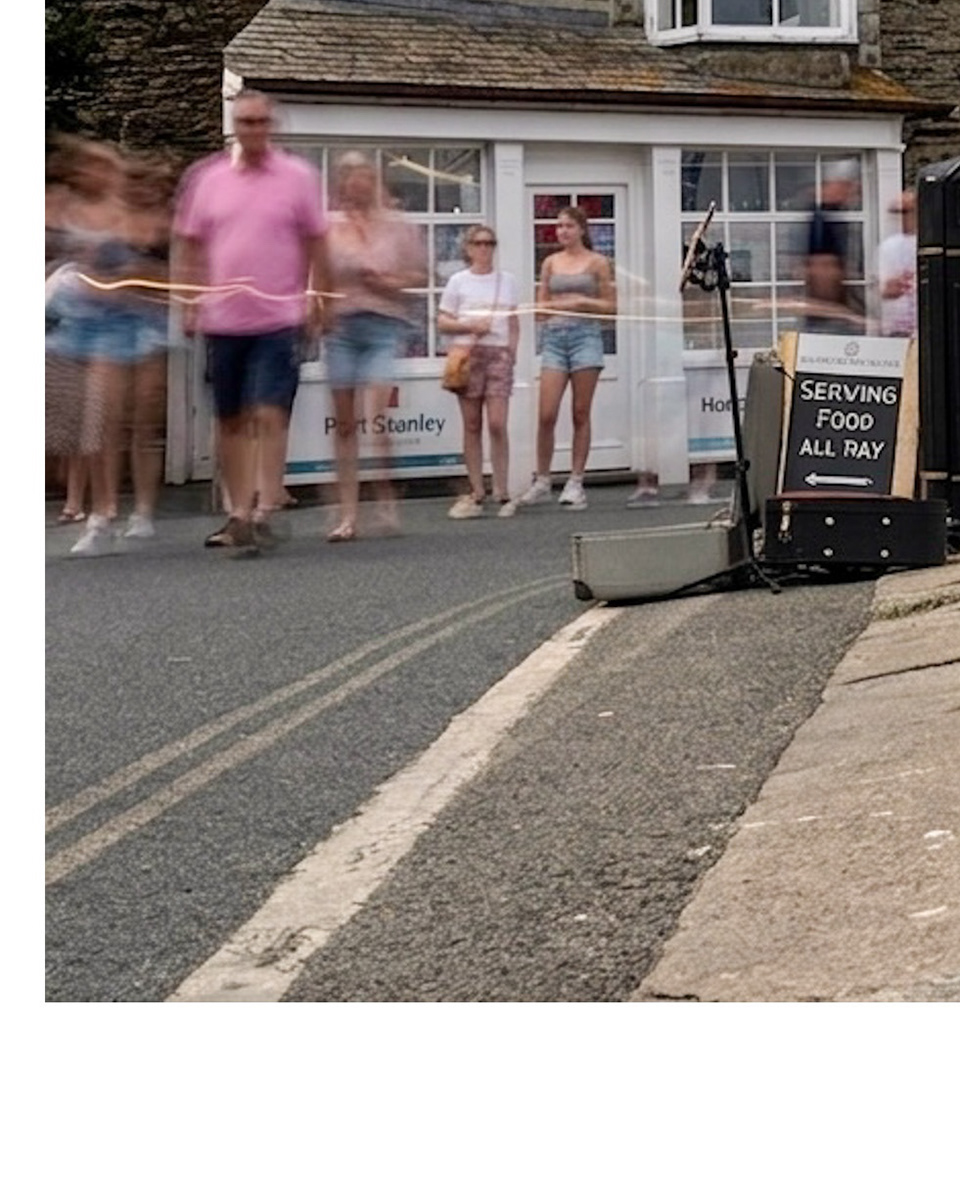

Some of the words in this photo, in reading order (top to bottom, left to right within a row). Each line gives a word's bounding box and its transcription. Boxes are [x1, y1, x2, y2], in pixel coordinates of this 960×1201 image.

[800, 379, 898, 405] SERVING
[373, 413, 446, 436] Stanley
[816, 408, 875, 431] FOOD
[798, 438, 836, 457] ALL
